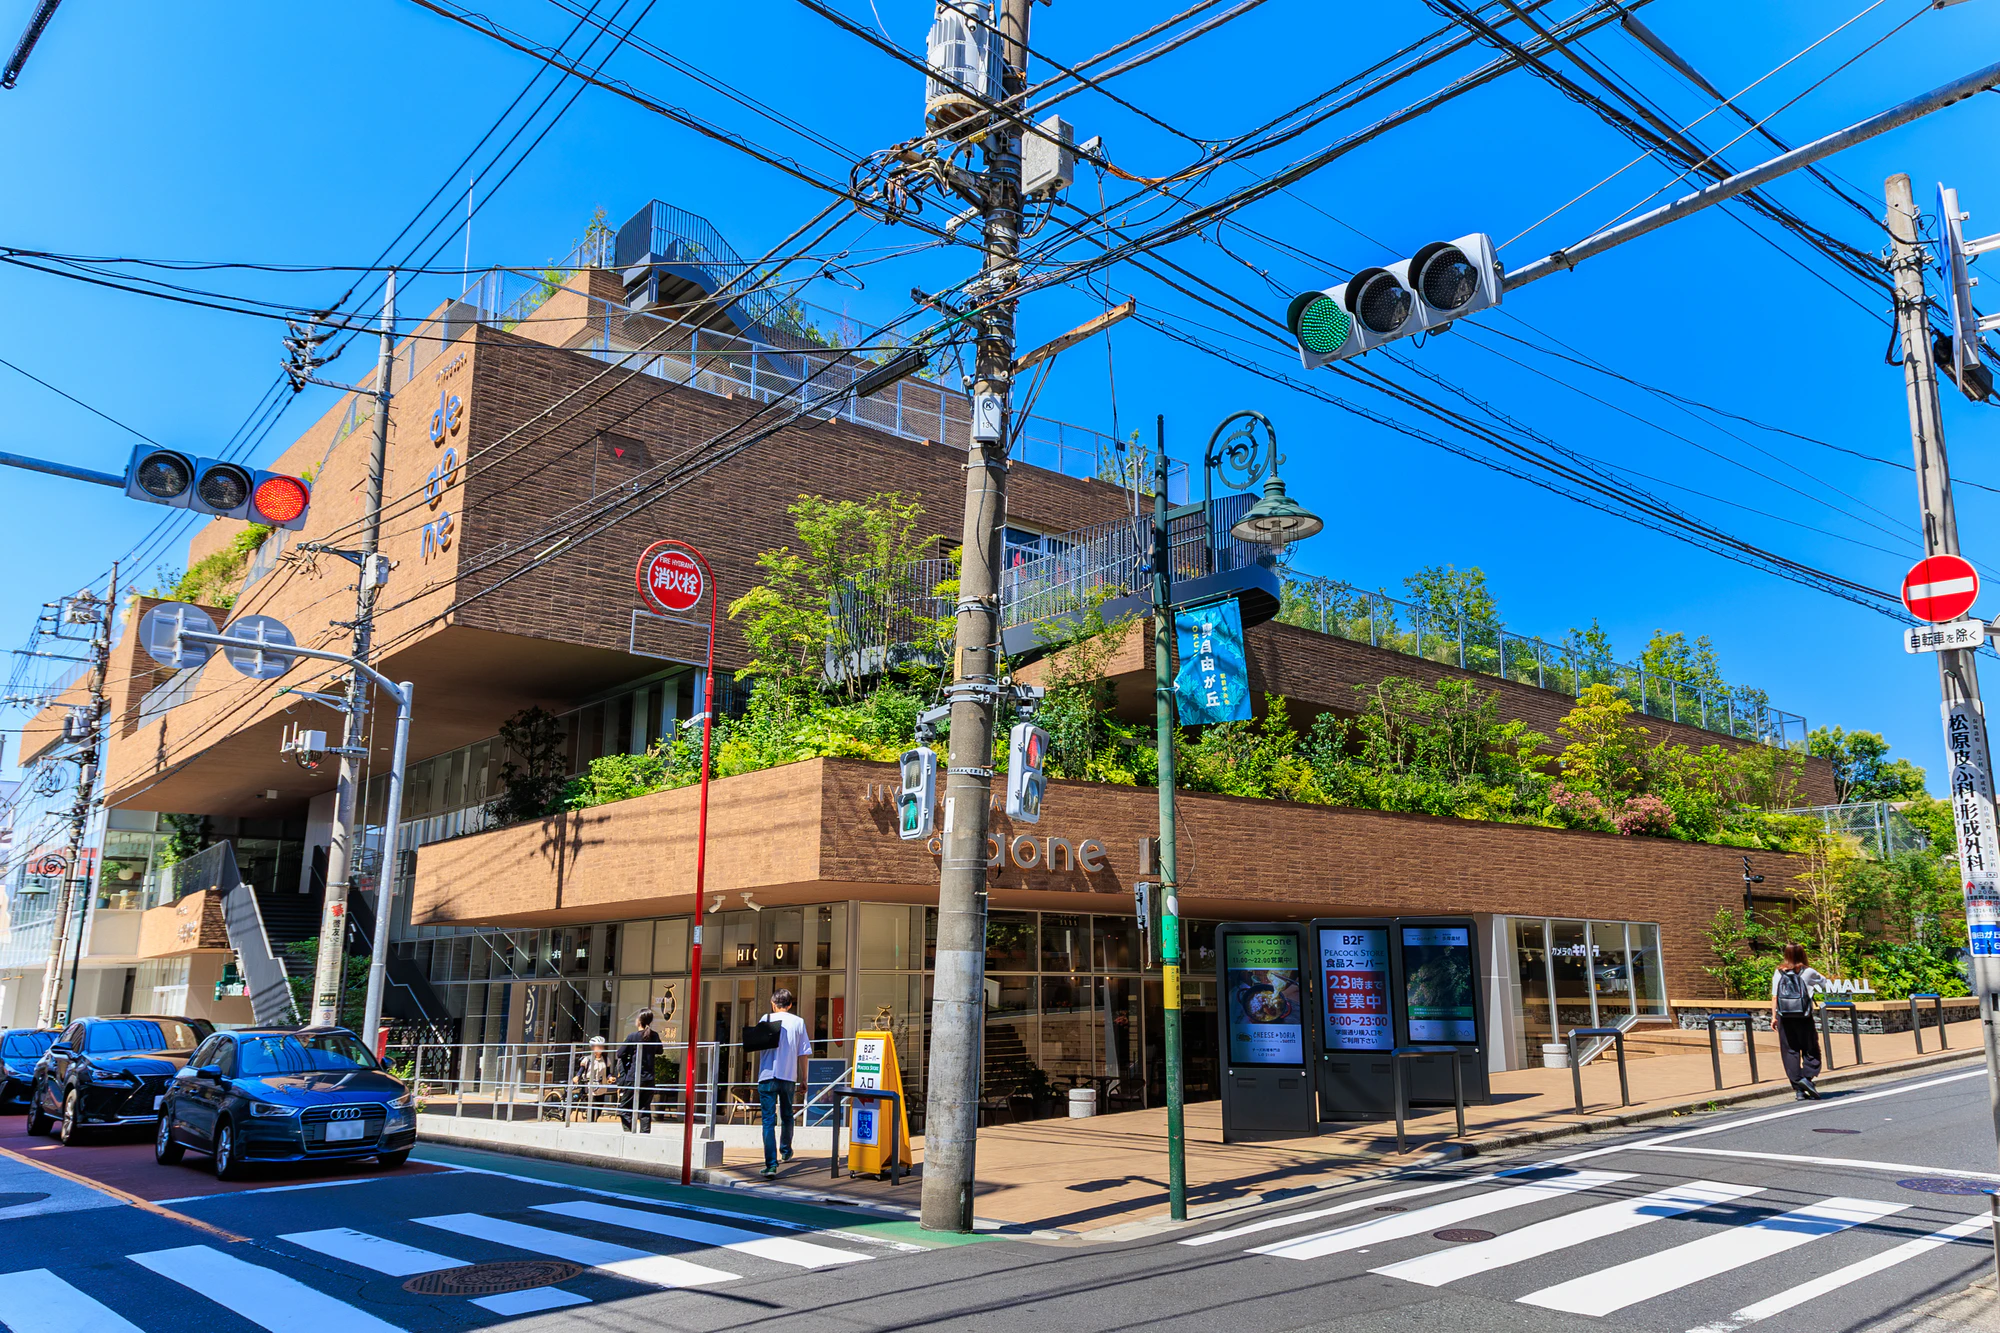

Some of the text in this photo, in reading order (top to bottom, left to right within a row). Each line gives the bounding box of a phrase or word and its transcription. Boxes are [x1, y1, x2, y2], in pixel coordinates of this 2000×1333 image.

[429, 389, 464, 446] de
[419, 510, 455, 565] ne
[660, 557, 694, 569] FIRE HYDRANT
[654, 566, 698, 595] 消火栓
[1912, 630, 1976, 647] 自転車を除く
[1200, 622, 1220, 707] 奥自由が丘
[1949, 714, 1985, 872] 松原皮ふ科・形成外科
[1266, 938, 1292, 946] aone
[1342, 935, 1364, 945] B2F
[1324, 948, 1385, 957] PEACOCK STORE
[1551, 944, 1600, 957] カメラのキタラ
[1326, 958, 1385, 969] 食品スーパー
[1329, 974, 1384, 990] 23時まで
[1825, 979, 1876, 993] MALL
[1332, 992, 1382, 1010] 営業中
[1253, 1031, 1296, 1039] CHEESE DORIA
[864, 1044, 875, 1053] B2F
[860, 1077, 873, 1088] 入口
